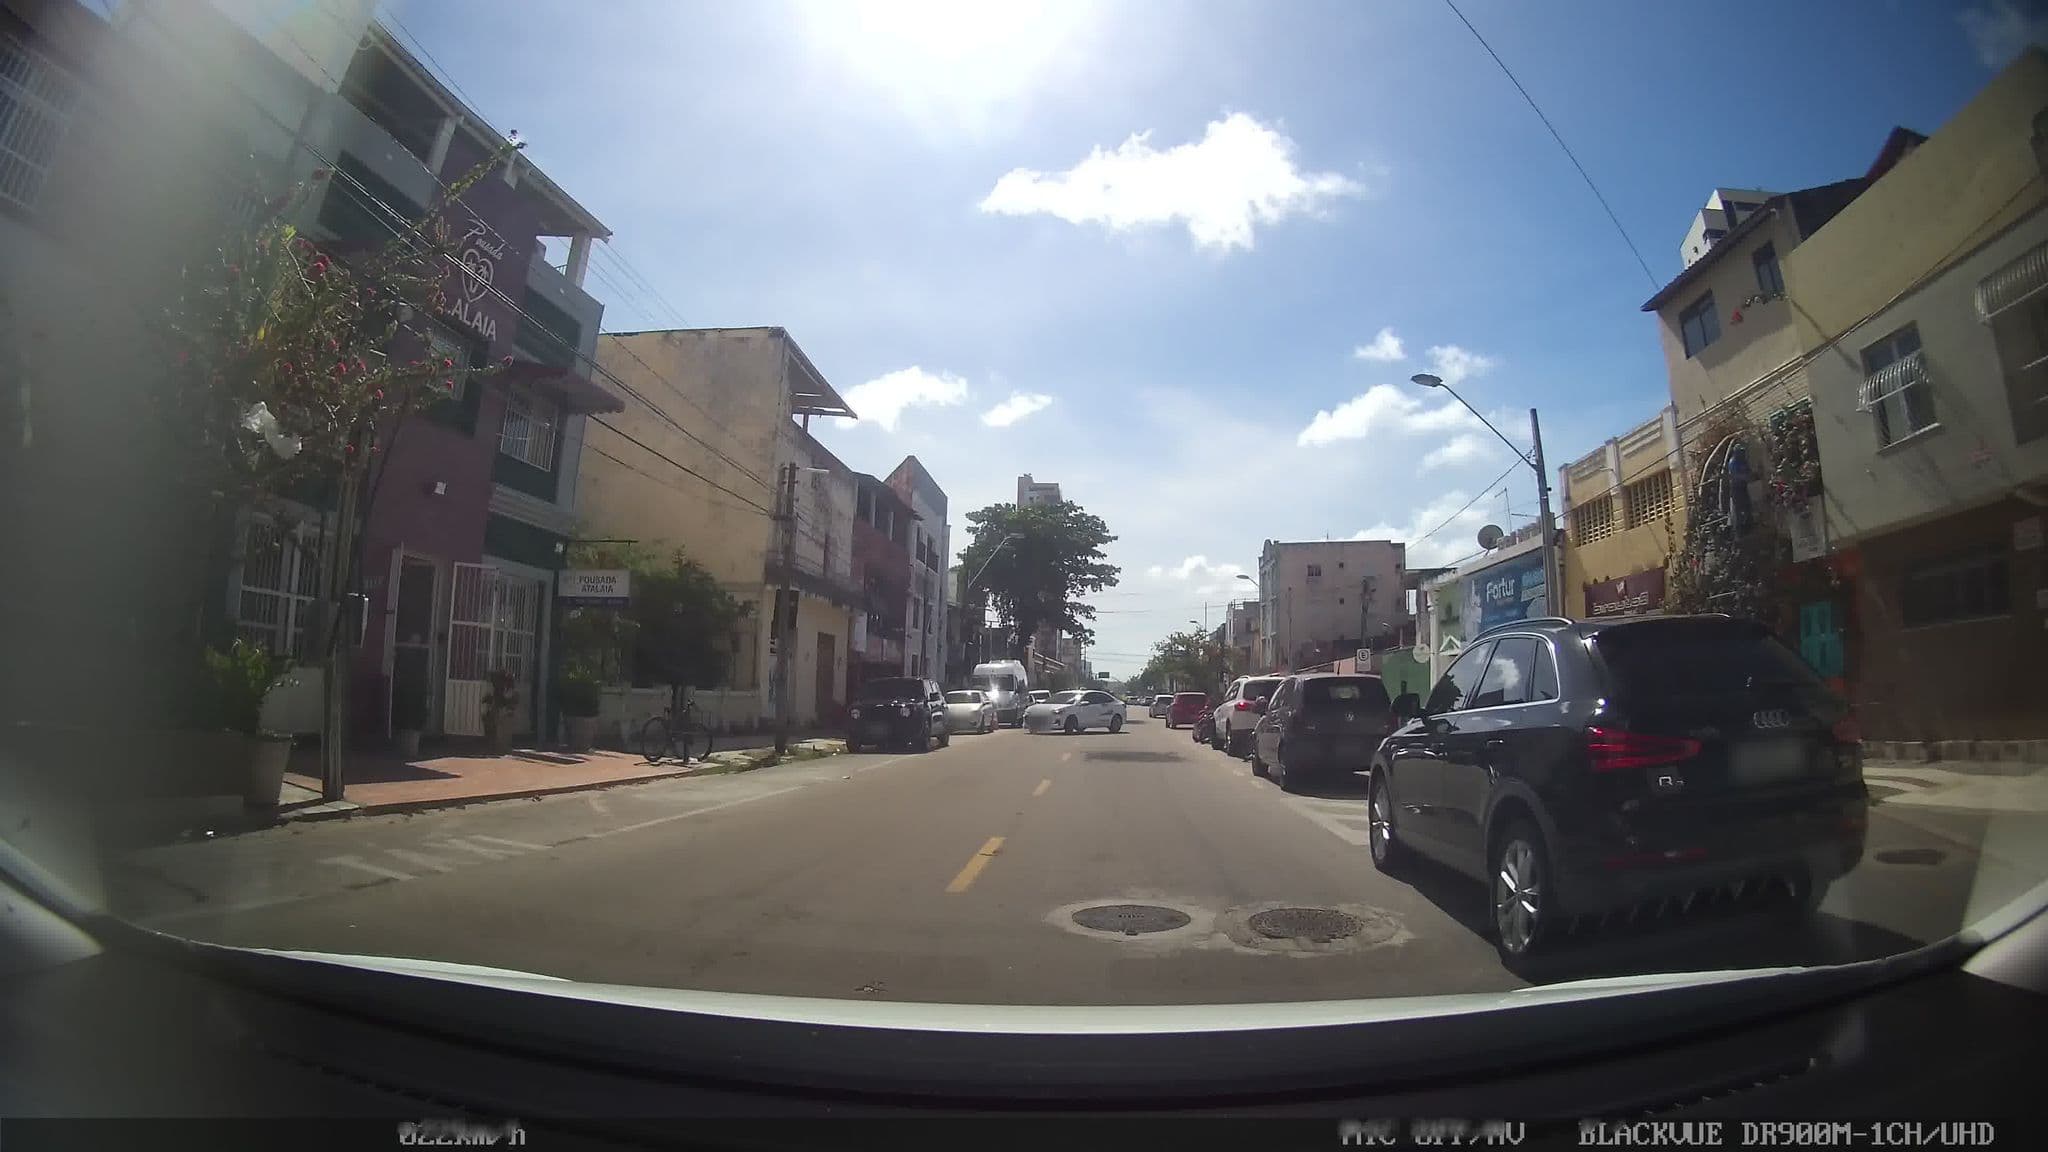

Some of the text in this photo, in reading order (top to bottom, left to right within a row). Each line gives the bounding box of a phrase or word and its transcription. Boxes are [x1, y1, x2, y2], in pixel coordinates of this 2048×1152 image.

[448, 299, 497, 341] ALAIA
[578, 576, 617, 584] POUSADA
[581, 584, 614, 593] ATALAIA
